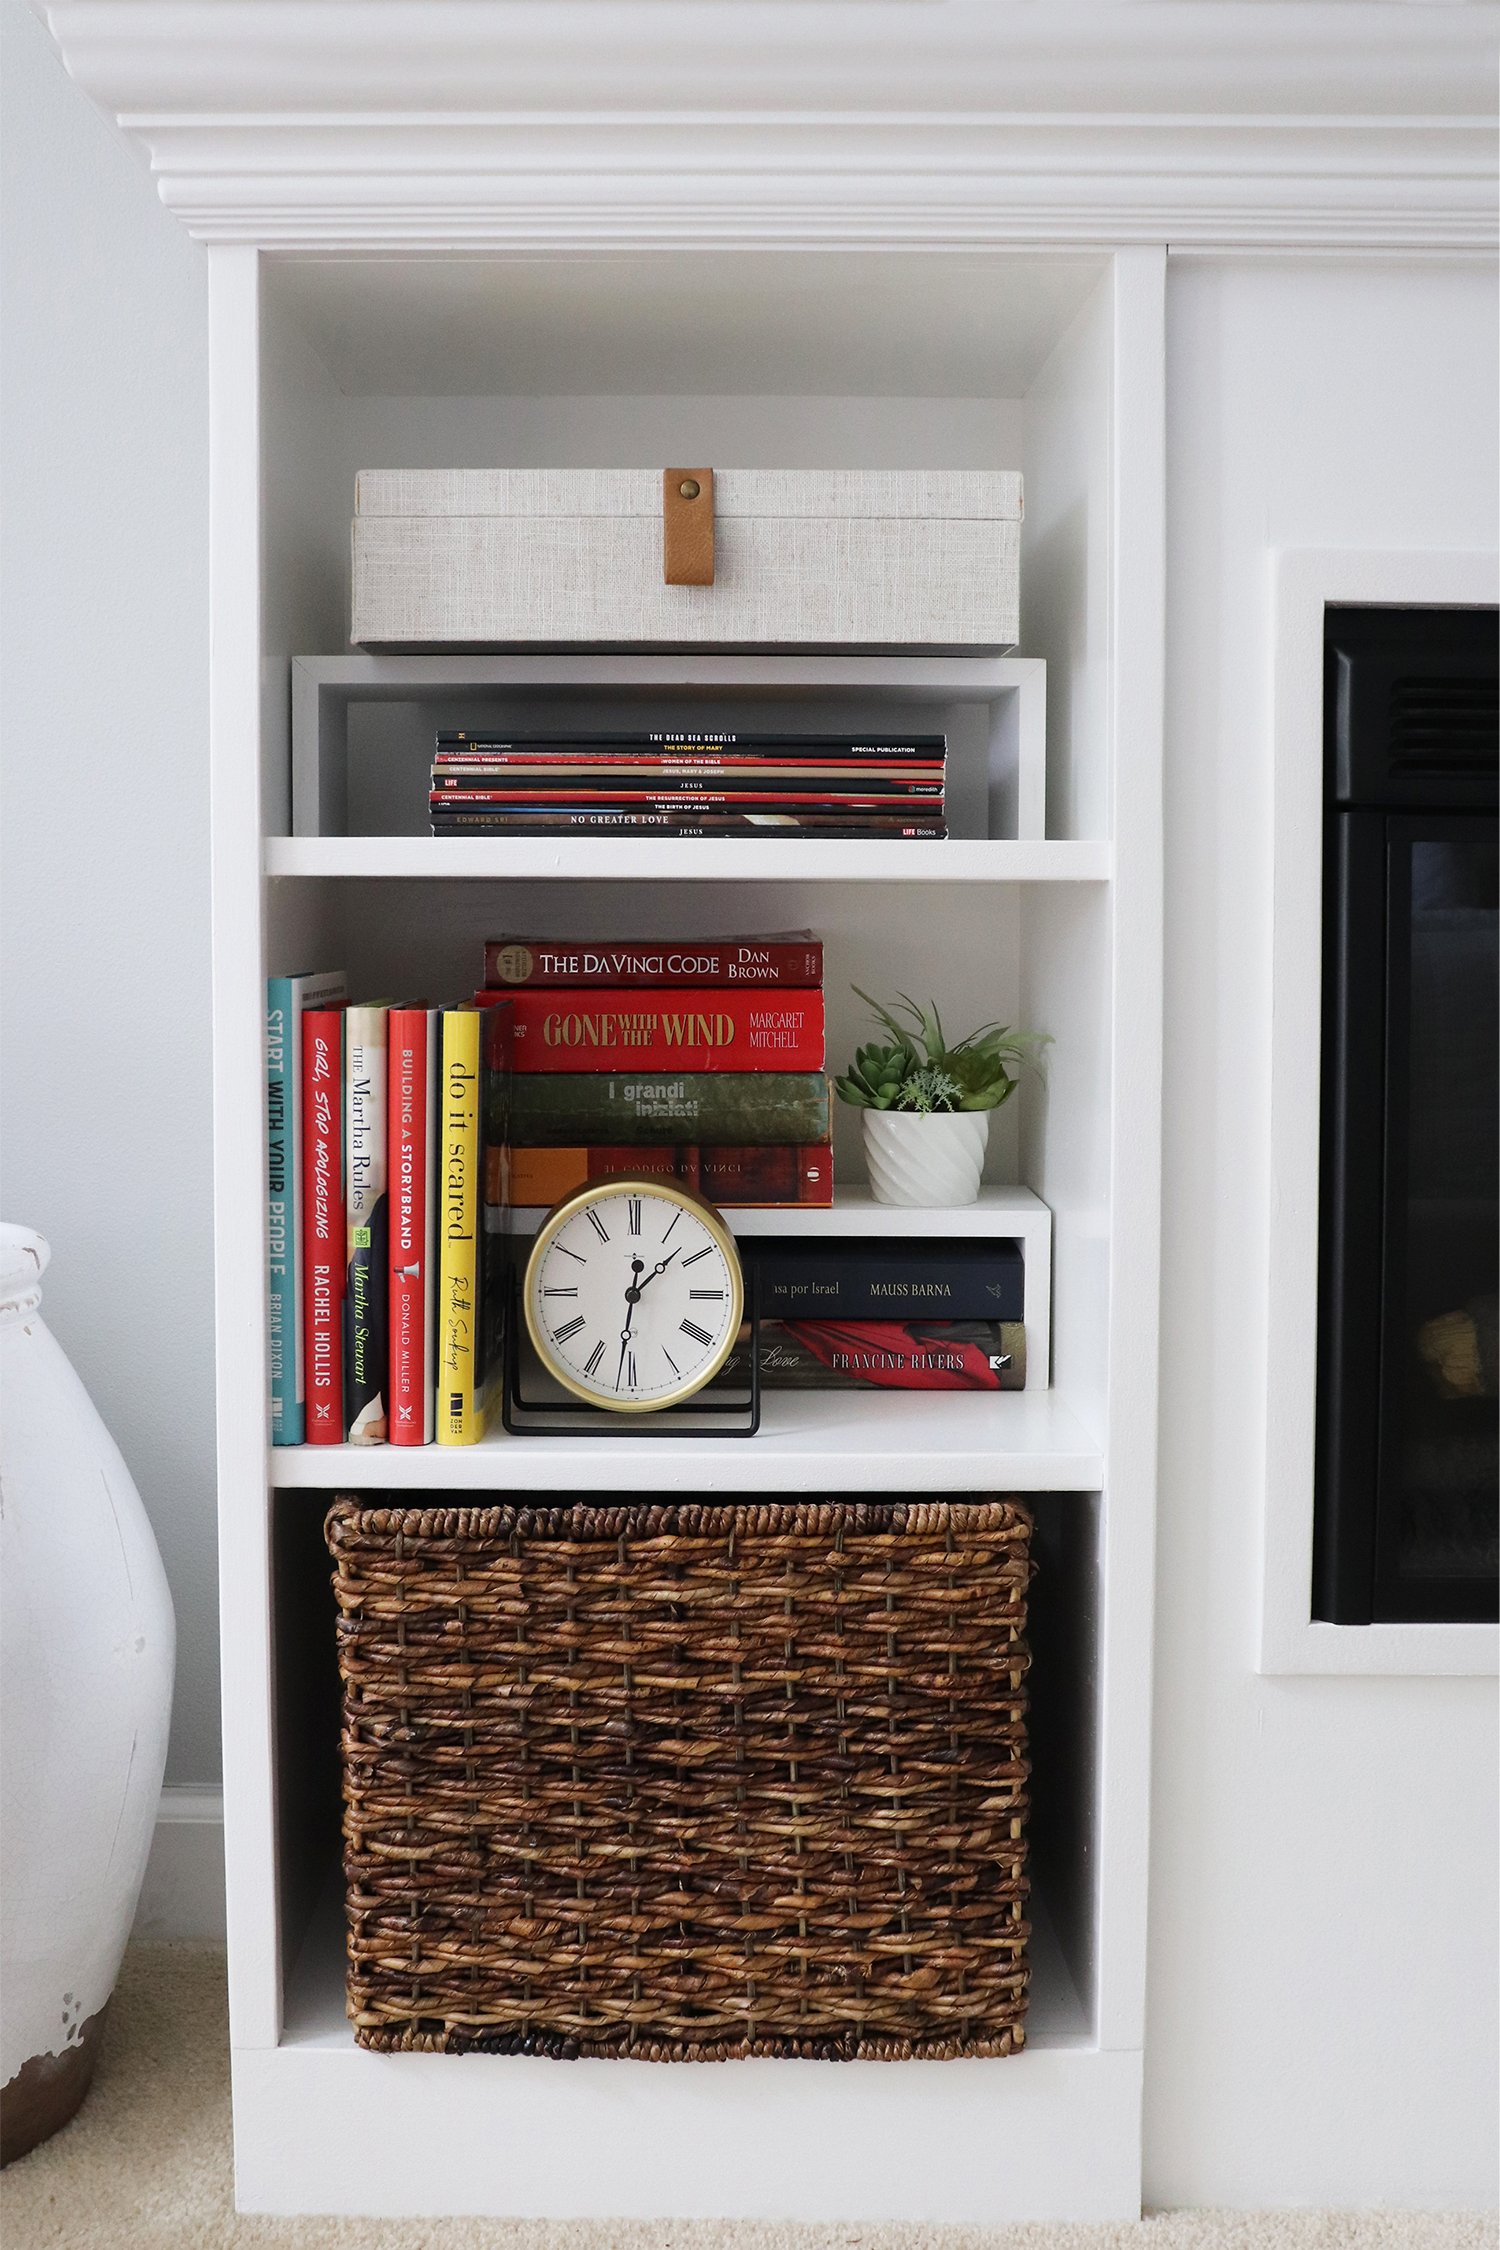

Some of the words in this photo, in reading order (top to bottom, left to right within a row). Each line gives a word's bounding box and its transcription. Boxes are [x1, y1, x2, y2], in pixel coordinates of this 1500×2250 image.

[649, 733, 663, 741] THE
[665, 733, 685, 742] DEAD
[687, 734, 701, 742] SEA
[704, 734, 737, 742] SCROLLS
[444, 779, 458, 787] LIFE
[570, 815, 586, 824] NO
[590, 814, 637, 824] GREATER
[641, 815, 669, 824] LOVE
[679, 827, 703, 835] JESUS
[902, 828, 916, 836] LIFE
[916, 828, 937, 836] Books
[540, 953, 579, 975] THE
[667, 953, 720, 975] CODE
[728, 965, 780, 980] BROWN
[738, 948, 770, 964] DAN
[543, 1012, 619, 1047] GONE
[617, 1013, 659, 1031] WITH
[621, 1029, 653, 1047] THE
[661, 1013, 735, 1047] WIND
[749, 1012, 805, 1030] MARGARET
[267, 1009, 284, 1074] START
[749, 1031, 799, 1049] MITCHELL
[312, 1037, 331, 1083] GIRL,
[352, 1045, 364, 1073] THE
[401, 1049, 413, 1124] BUILDING
[449, 1062, 476, 1099] do
[623, 1081, 685, 1102] grandi
[268, 1080, 284, 1131] WITH
[315, 1090, 332, 1135] STOP
[352, 1076, 371, 1150] Martha
[448, 1110, 474, 1133] it
[401, 1128, 412, 1139] A
[269, 1139, 284, 1193] YOUR
[352, 1154, 371, 1210] Rules
[704, 1163, 742, 1173] VINCI
[315, 1139, 330, 1239] APOLOGIZING
[401, 1144, 413, 1250] STORYBRAND
[447, 1143, 473, 1243] scared
[270, 1202, 286, 1276] PEOPLE
[314, 1265, 331, 1326] RACHEL
[354, 1262, 370, 1320] Martha
[448, 1276, 471, 1315] Ruth
[790, 1284, 809, 1299] por
[812, 1281, 840, 1294] Israel
[869, 1283, 909, 1297] MAUSS
[911, 1283, 951, 1297] BARNA
[271, 1293, 283, 1334] BRIAN
[401, 1293, 411, 1345] DONALD
[272, 1340, 283, 1379] DIXON
[315, 1332, 331, 1387] HOLLIS
[354, 1325, 370, 1385] Stewart
[443, 1318, 470, 1372] Soukup
[759, 1345, 800, 1373] Love
[832, 1353, 905, 1370] FRANCINE
[910, 1353, 965, 1370] RIVERS
[401, 1350, 411, 1393] MILLER
